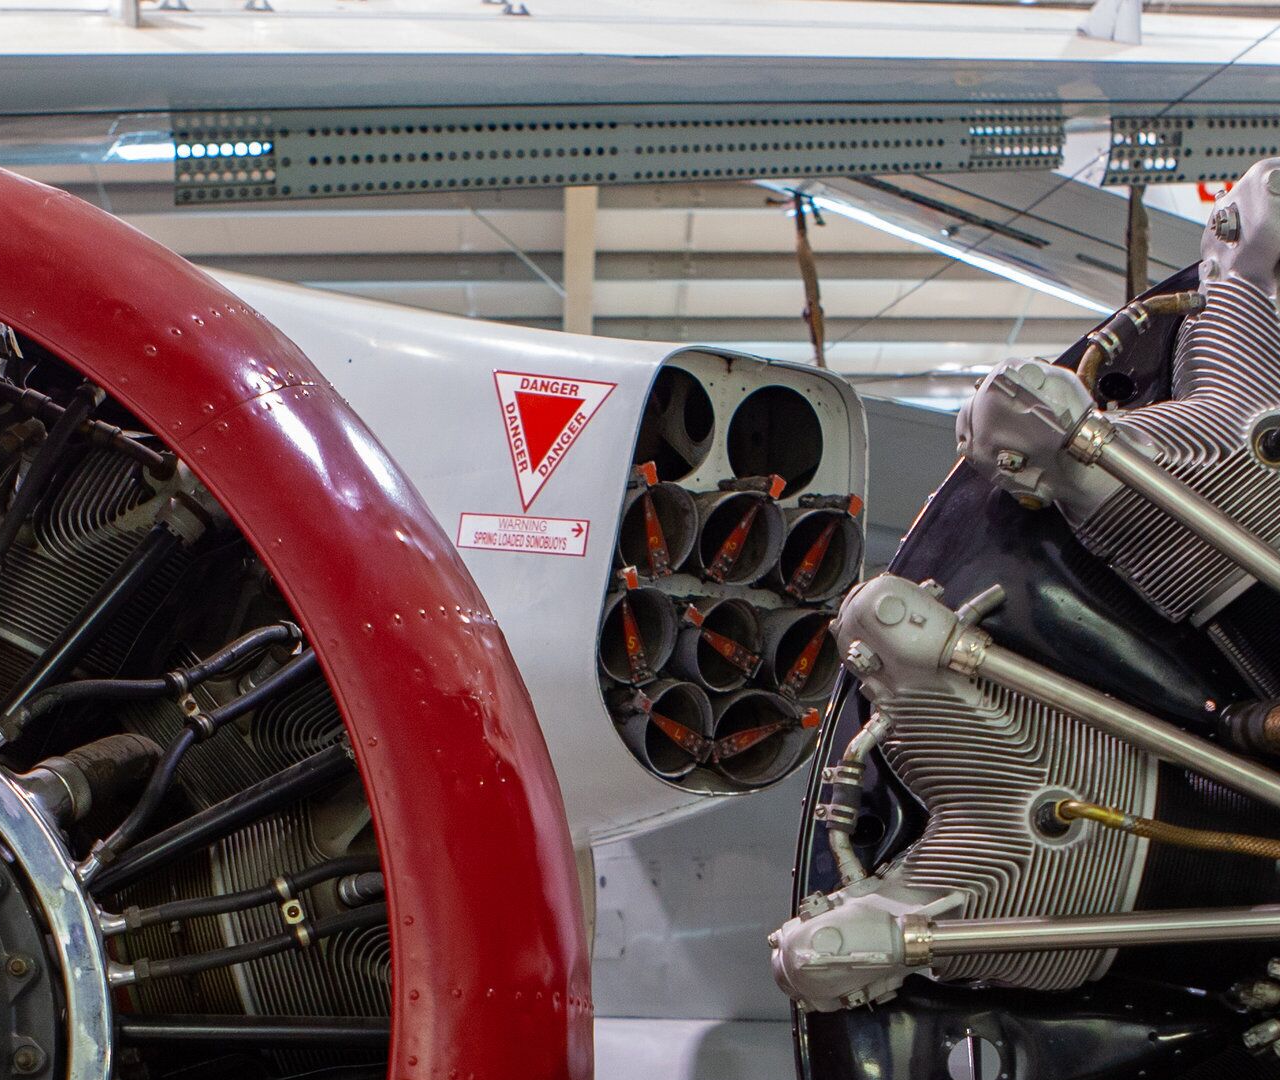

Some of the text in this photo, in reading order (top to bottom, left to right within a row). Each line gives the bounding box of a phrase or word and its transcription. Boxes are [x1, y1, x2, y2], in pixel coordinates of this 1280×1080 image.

[520, 378, 579, 396] DANGER
[506, 402, 528, 473] DANGER
[538, 412, 586, 477] DANGER
[498, 518, 548, 532] WARNING
[474, 531, 568, 551] SPRING LOADED SONOBUOYS
[627, 635, 637, 650] 5
